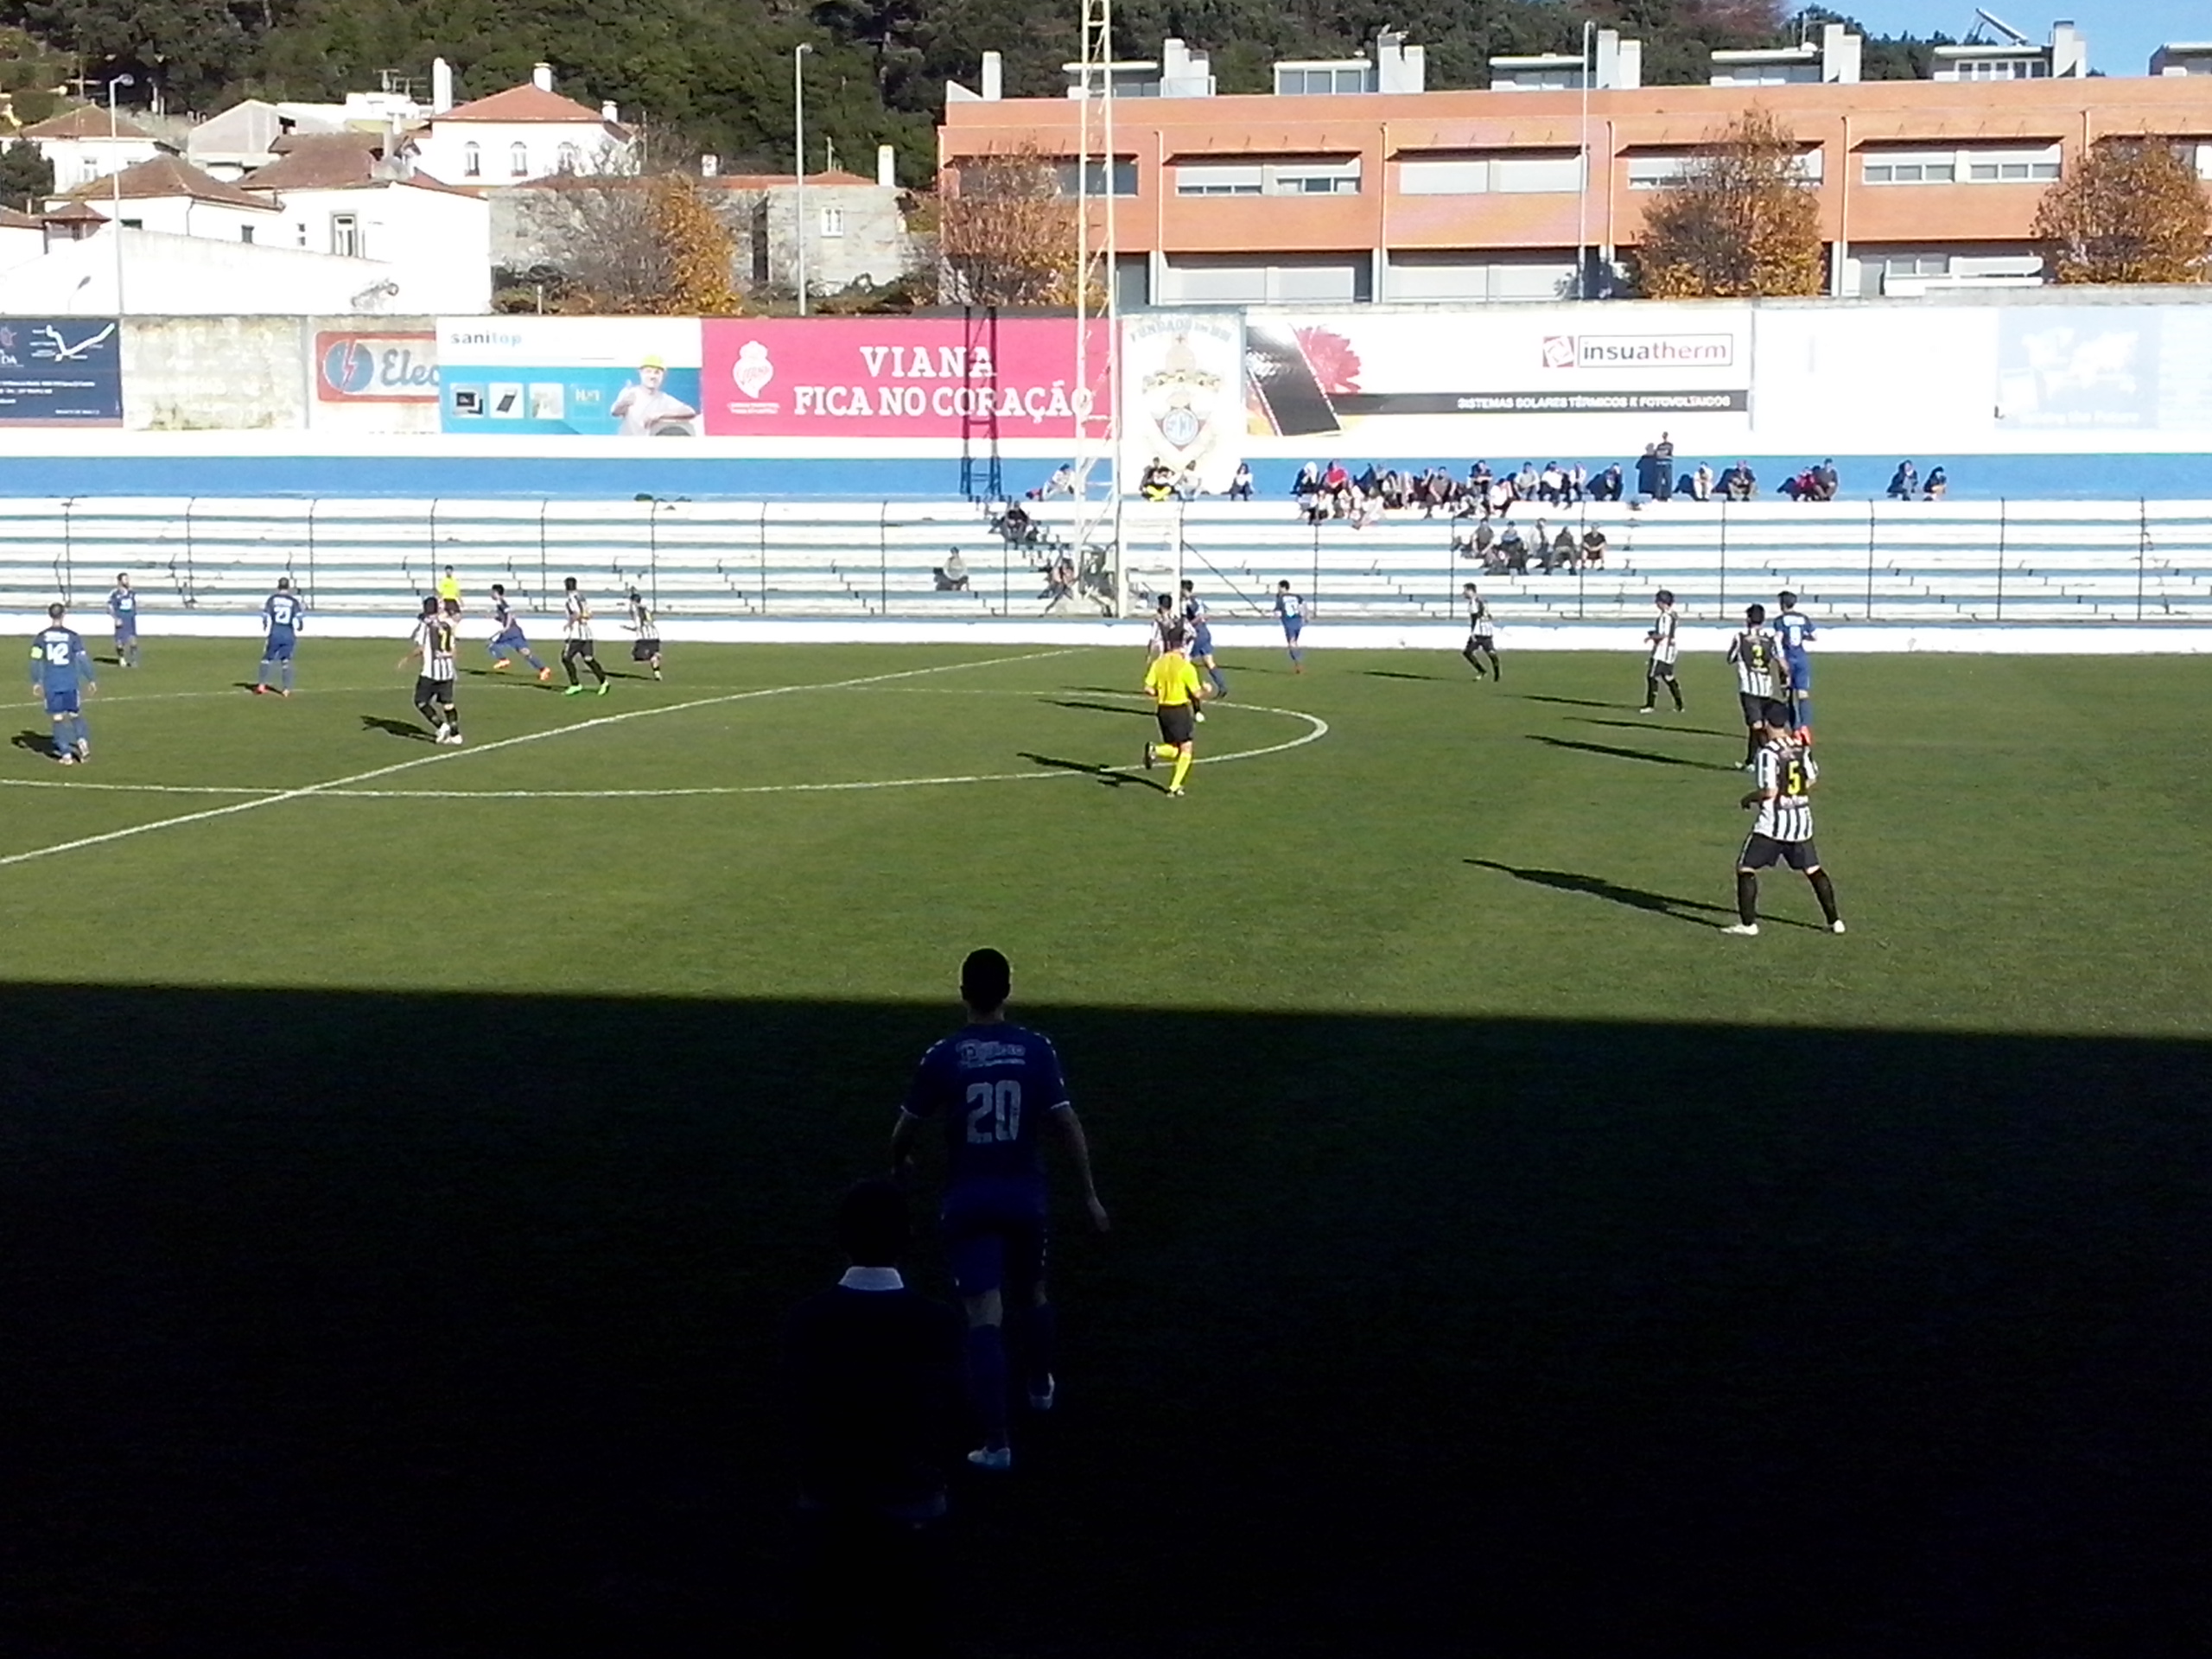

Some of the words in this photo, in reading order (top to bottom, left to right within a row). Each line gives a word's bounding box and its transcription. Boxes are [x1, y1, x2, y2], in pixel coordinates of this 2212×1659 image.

[450, 329, 522, 347] sanitop
[1583, 341, 1727, 361] insuatherm
[859, 346, 997, 378] VIANA
[794, 385, 874, 416] FICA
[879, 385, 926, 416] NO
[932, 380, 1094, 423] CORAÇÃO
[1457, 397, 1514, 410] SISTEMAS
[1516, 397, 1567, 409] SOLARES
[1569, 396, 1628, 409] TÉRMICOS
[1639, 396, 1731, 408] FOTOVOLTAICOS
[1788, 760, 1800, 795] 5
[966, 1079, 1021, 1145] 20
